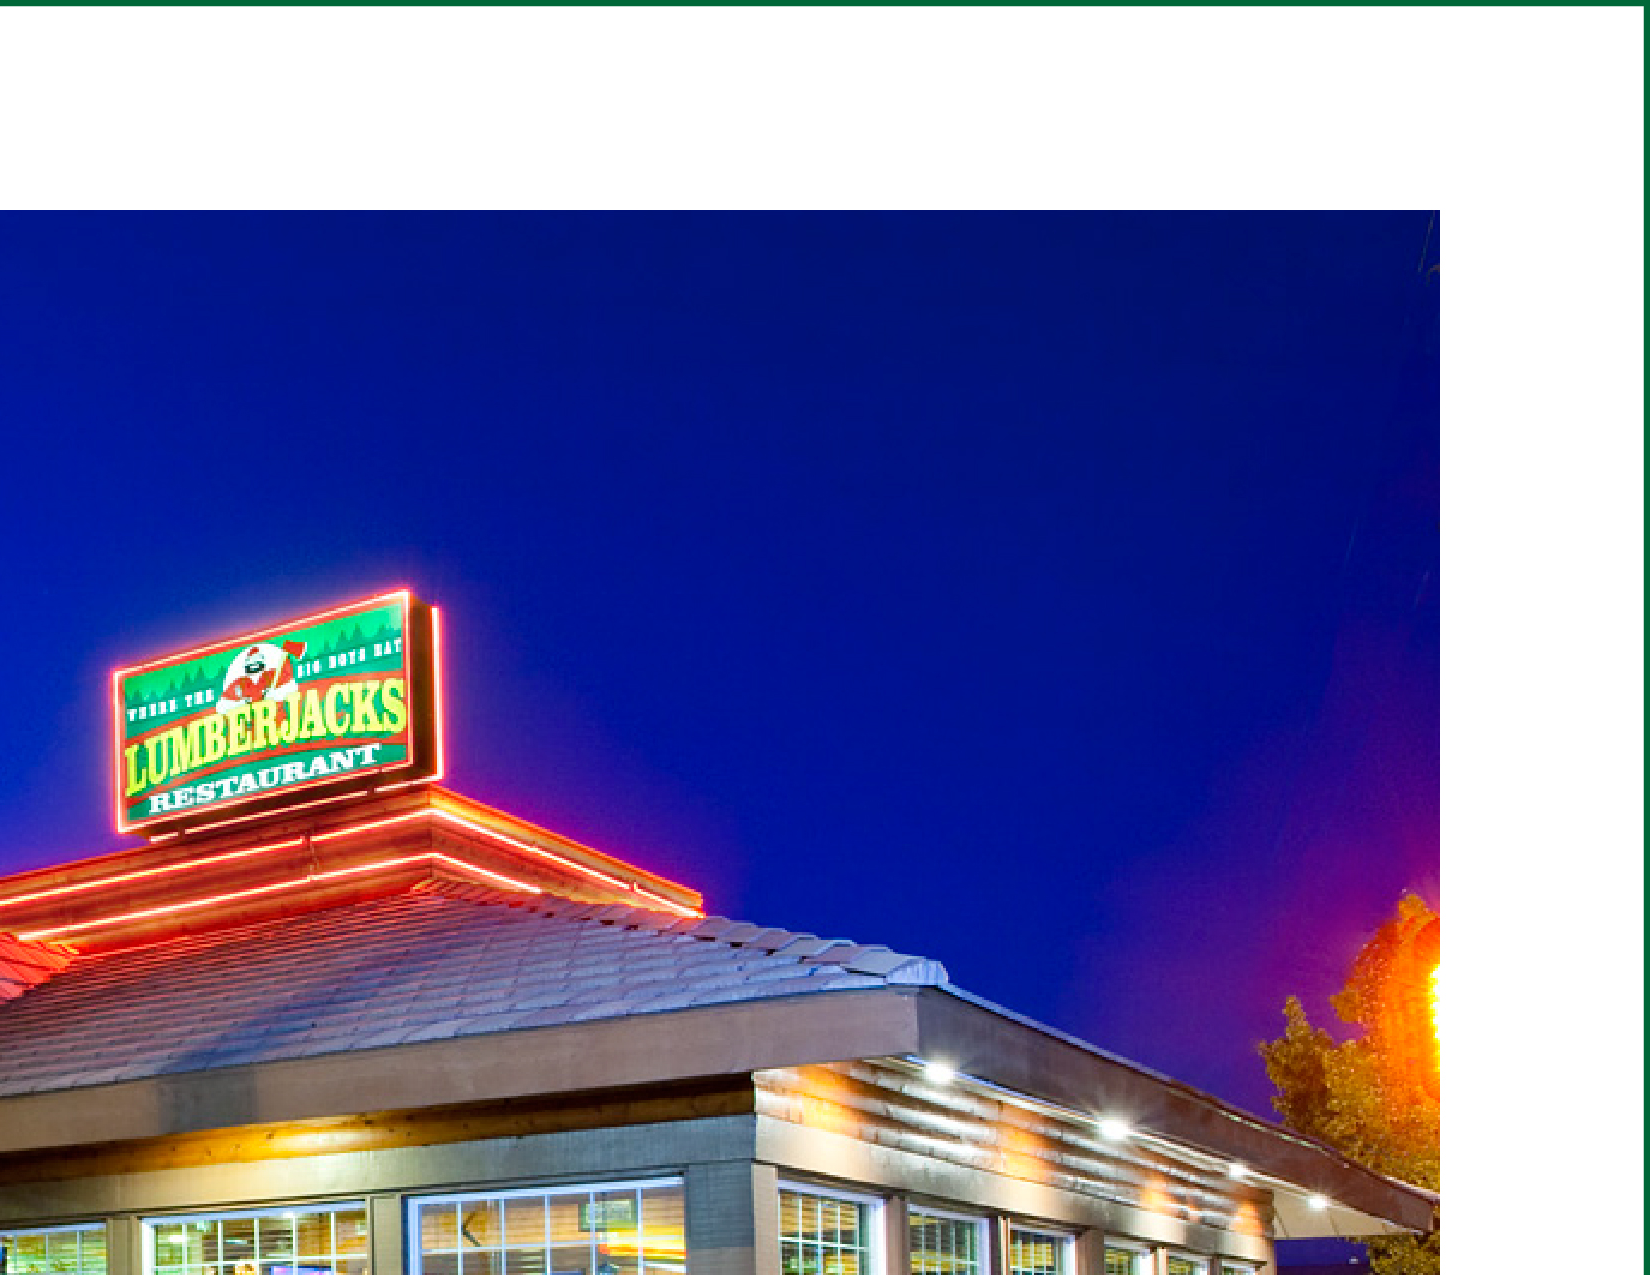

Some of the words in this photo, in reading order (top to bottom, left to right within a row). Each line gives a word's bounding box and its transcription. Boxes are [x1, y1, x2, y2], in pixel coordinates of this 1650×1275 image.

[185, 689, 214, 708] THE
[125, 678, 406, 797] LUMBERJACKS
[149, 743, 381, 813] RESTAURANT
